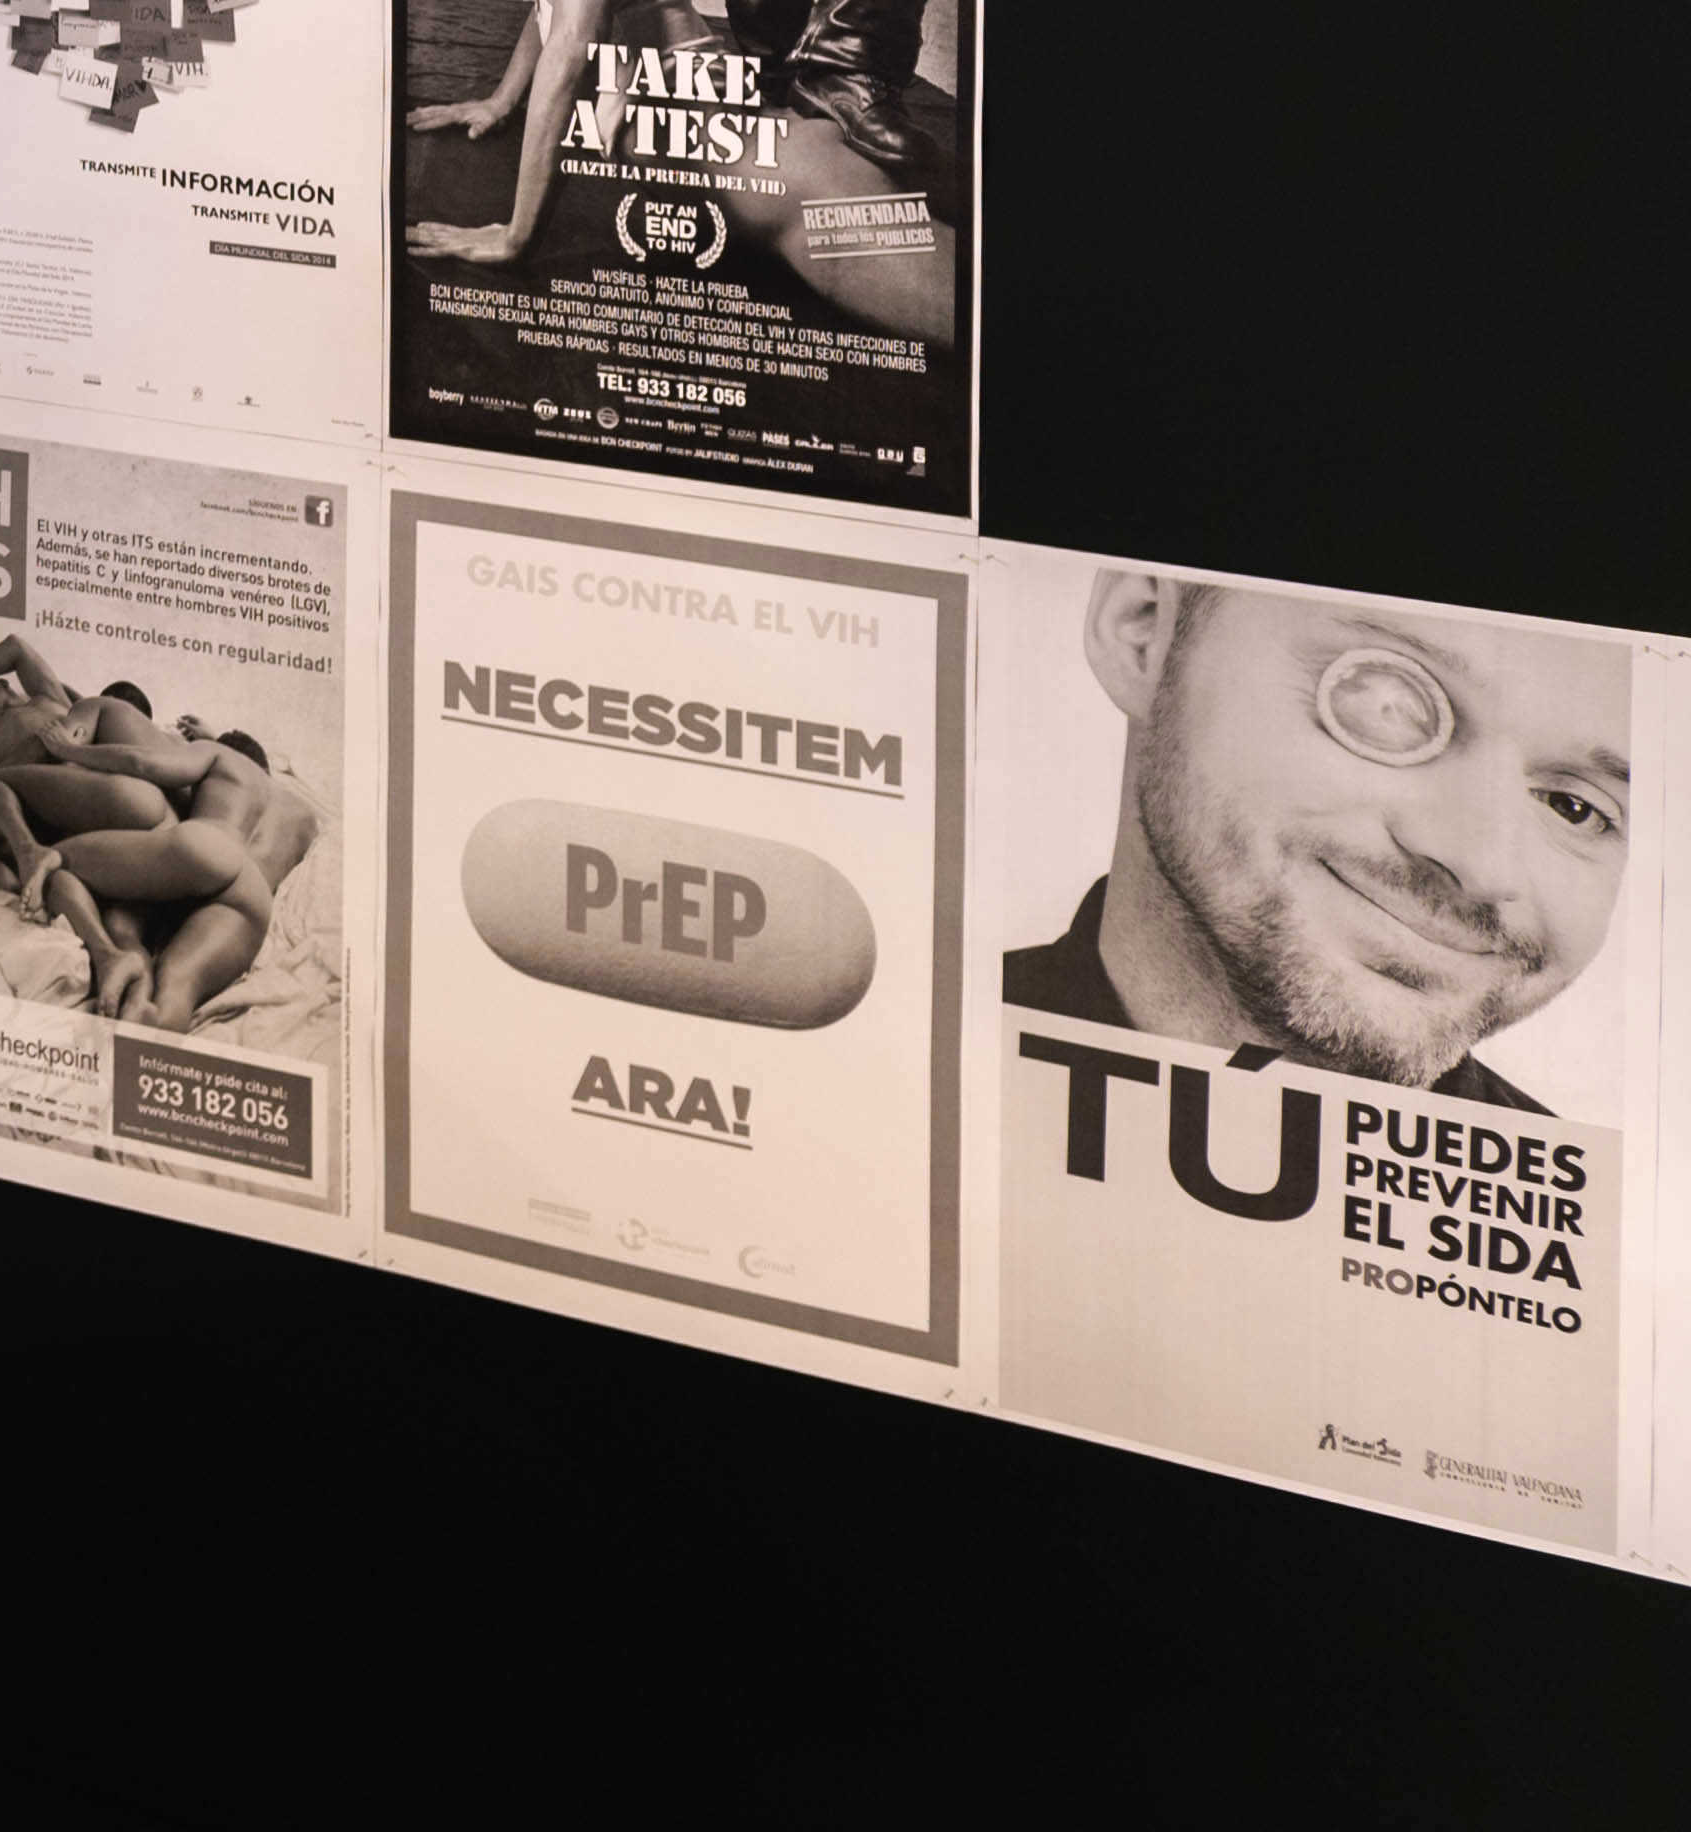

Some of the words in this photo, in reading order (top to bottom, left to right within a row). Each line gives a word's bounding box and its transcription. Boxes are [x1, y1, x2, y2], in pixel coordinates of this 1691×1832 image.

[587, 42, 762, 108] TAKE
[561, 98, 604, 151] A
[625, 104, 788, 168] TEST
[80, 159, 157, 180] TRANSMITE
[161, 168, 335, 206] INFORMACIÓN
[621, 165, 641, 181] LA
[646, 168, 711, 187] PRUEBA
[715, 176, 746, 192] DEL
[192, 203, 270, 225] TRANSMITE
[276, 212, 335, 238] VIDA
[645, 202, 673, 217] PUT
[677, 205, 697, 218] AN
[646, 217, 697, 239] END
[802, 200, 931, 230] RECOMENDADA
[647, 239, 666, 252] TO
[671, 241, 695, 254] HIV
[597, 373, 632, 392] TEL:
[637, 377, 671, 397] 933
[676, 380, 709, 402] 182
[712, 385, 746, 407] 056
[37, 519, 50, 532] El
[54, 522, 77, 537] VIH
[81, 530, 88, 542] y
[92, 530, 127, 546] otras
[132, 535, 153, 550] ITS
[158, 540, 196, 557] están
[466, 552, 559, 597] GAIS
[573, 570, 738, 626] CONTRA
[754, 599, 793, 637] EL
[806, 604, 879, 649] VIH
[96, 620, 177, 648] controles
[182, 638, 213, 654] con
[219, 642, 332, 674] regularidad!
[441, 659, 905, 788] NECESSITEM
[564, 842, 768, 964] PrEP
[571, 1054, 753, 1137] ARA!
[1019, 1031, 1322, 1223] TÚ
[1346, 1099, 1587, 1192] PUEDES
[1344, 1152, 1584, 1237] PREVENIR
[1344, 1194, 1405, 1251] EL
[1428, 1214, 1583, 1290] SIDA
[1341, 1257, 1582, 1334] PROPÓNTELO
